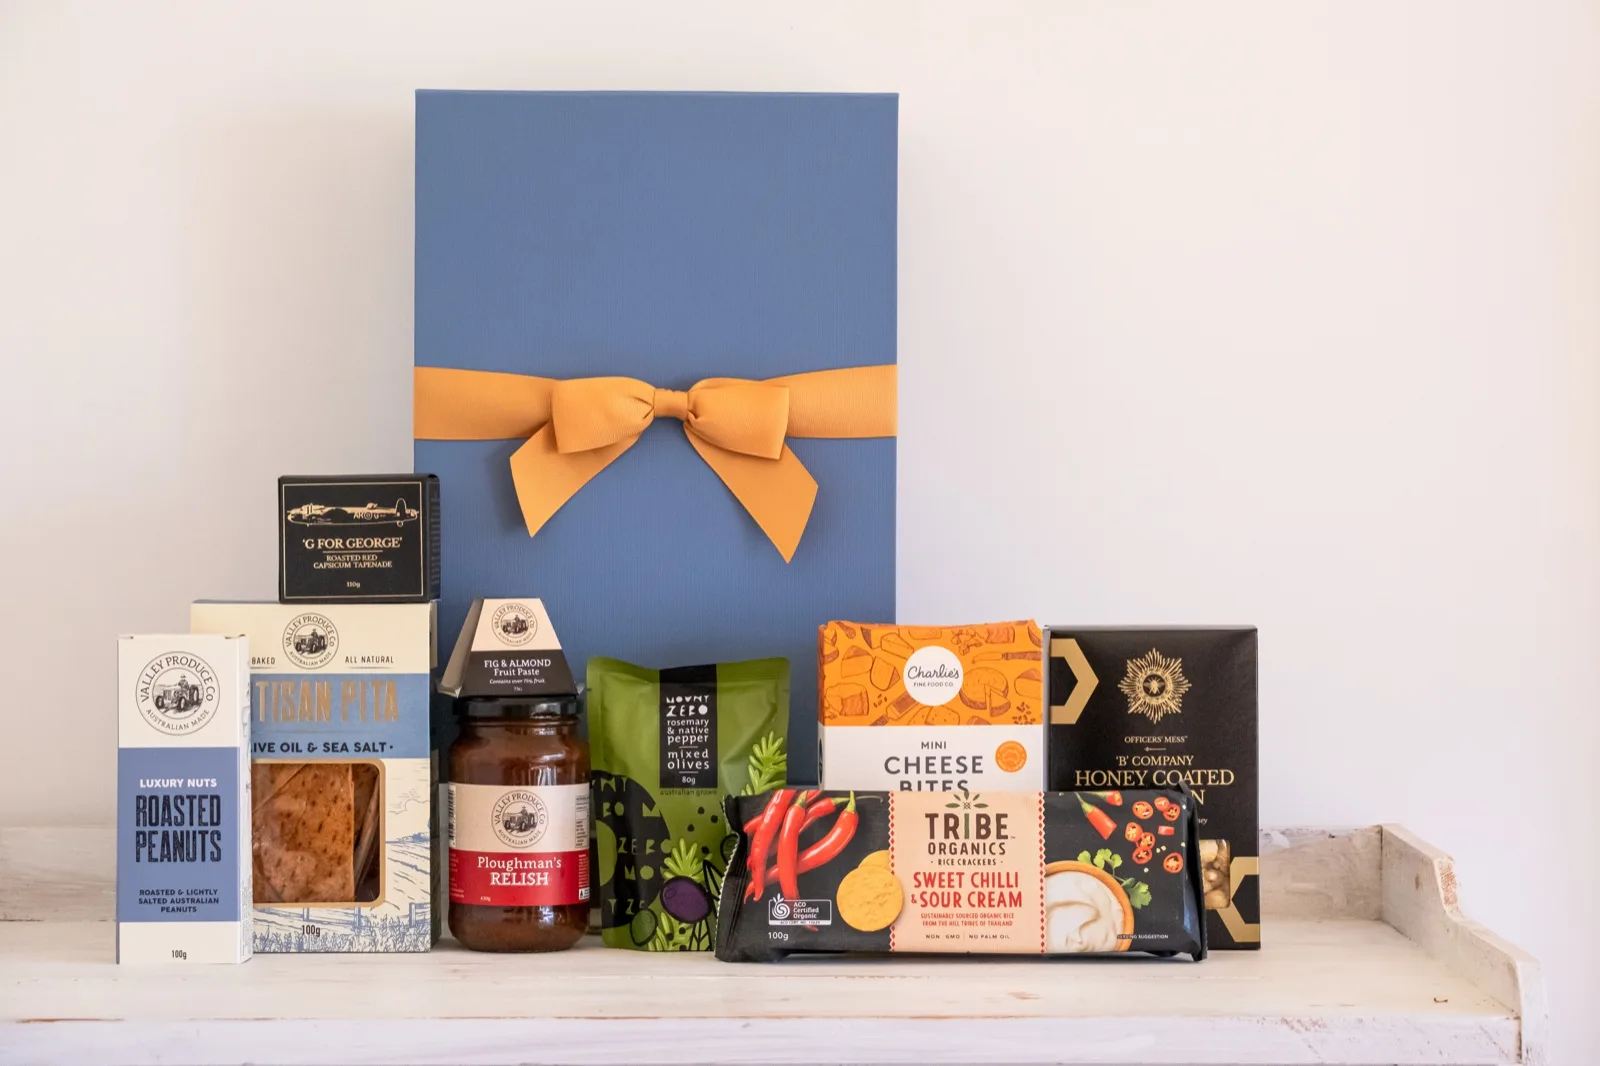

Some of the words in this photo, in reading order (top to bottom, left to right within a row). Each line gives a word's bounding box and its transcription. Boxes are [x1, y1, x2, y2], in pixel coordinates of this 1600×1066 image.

[318, 538, 344, 549] FOR
[346, 537, 402, 548] GEORGE'
[326, 554, 360, 562] ROASTED
[286, 618, 301, 647] VALLEY
[303, 616, 334, 634] PRODUCE
[252, 657, 276, 665] BAKED
[484, 660, 499, 668] FIG
[509, 659, 551, 668] ALMOND
[518, 668, 540, 676] Paste
[908, 664, 959, 680] Charlie's
[140, 660, 164, 703] VALLEY
[165, 656, 213, 685] PRODUCE
[341, 680, 398, 722] PITA
[666, 704, 708, 717] ZERO
[146, 709, 189, 730] AUSTRALIAN
[191, 709, 210, 727] MADE
[667, 719, 709, 727] rosemary
[667, 727, 674, 735] &
[678, 726, 709, 734] native
[667, 735, 709, 745] pepper
[921, 741, 947, 750] MINI
[280, 742, 302, 752] OIL
[307, 742, 317, 752] &
[323, 742, 349, 752] SEA
[668, 749, 709, 758] mixed
[668, 759, 710, 770] olives
[884, 755, 984, 775] CHEESE
[1132, 755, 1194, 766] COMPANY
[140, 779, 184, 788] LUXURY
[187, 778, 217, 787] NUTS
[682, 776, 696, 785] 80g
[1075, 770, 1148, 787] HONEY
[1153, 769, 1234, 786] COATED
[136, 794, 221, 827] ROASTED
[495, 798, 511, 825] VALLEY
[512, 793, 544, 811] PRODUCE
[925, 813, 1008, 840] TRIBE
[498, 829, 528, 845] AUSTRALIAN
[136, 830, 221, 863] PEANUTS
[928, 842, 1006, 855] ORGANICS
[477, 857, 561, 871] Ploughman's
[958, 858, 996, 866] CRACKERS
[490, 872, 549, 886] RELISH
[913, 871, 965, 888] SWEET
[971, 871, 1019, 888] CHILLI
[911, 894, 917, 904] &
[920, 891, 962, 908] SOUR
[968, 891, 1022, 908] CREAM
[301, 924, 321, 937] 100g
[768, 932, 789, 940] 100g
[172, 950, 187, 960] 100g
